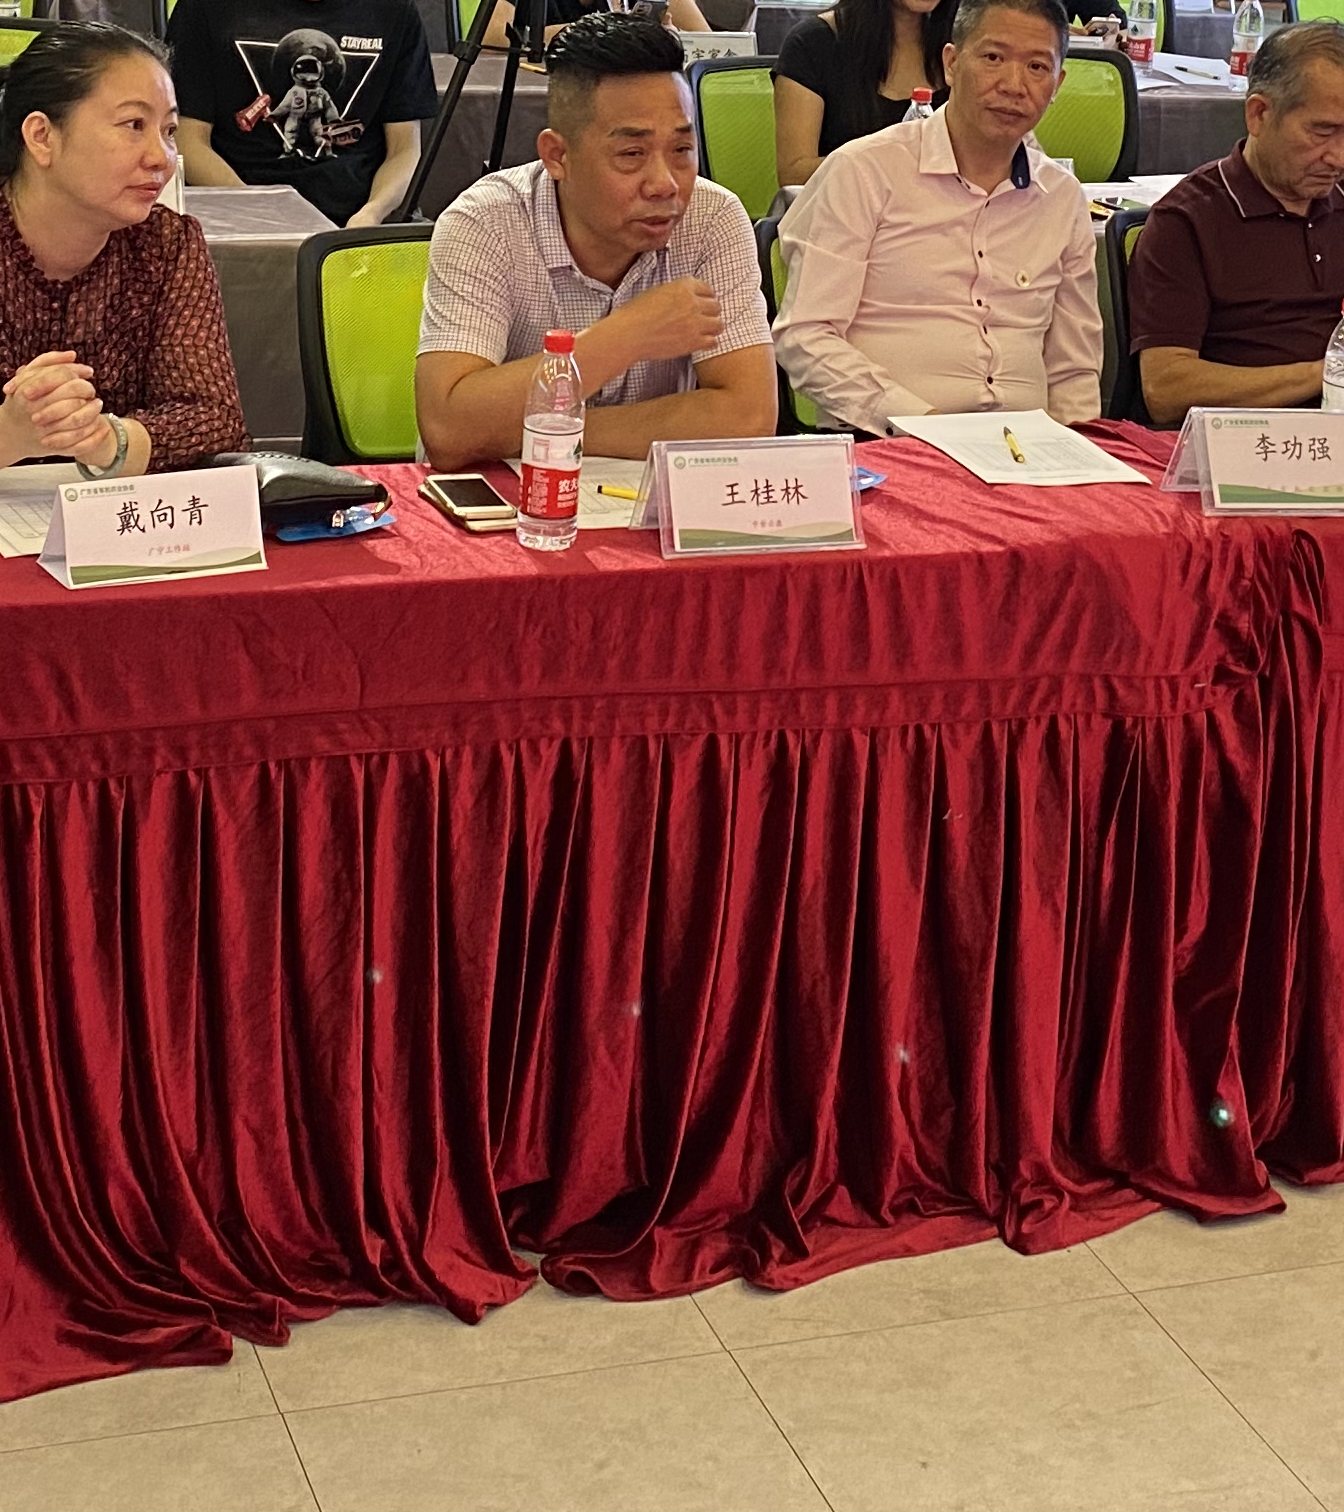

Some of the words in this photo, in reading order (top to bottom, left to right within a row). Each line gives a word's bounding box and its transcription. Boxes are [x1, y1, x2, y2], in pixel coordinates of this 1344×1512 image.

[339, 35, 384, 50] STAYREAL
[1254, 432, 1333, 462] 李功强
[720, 476, 810, 508] 王桂林
[115, 495, 211, 538] 戴向青
